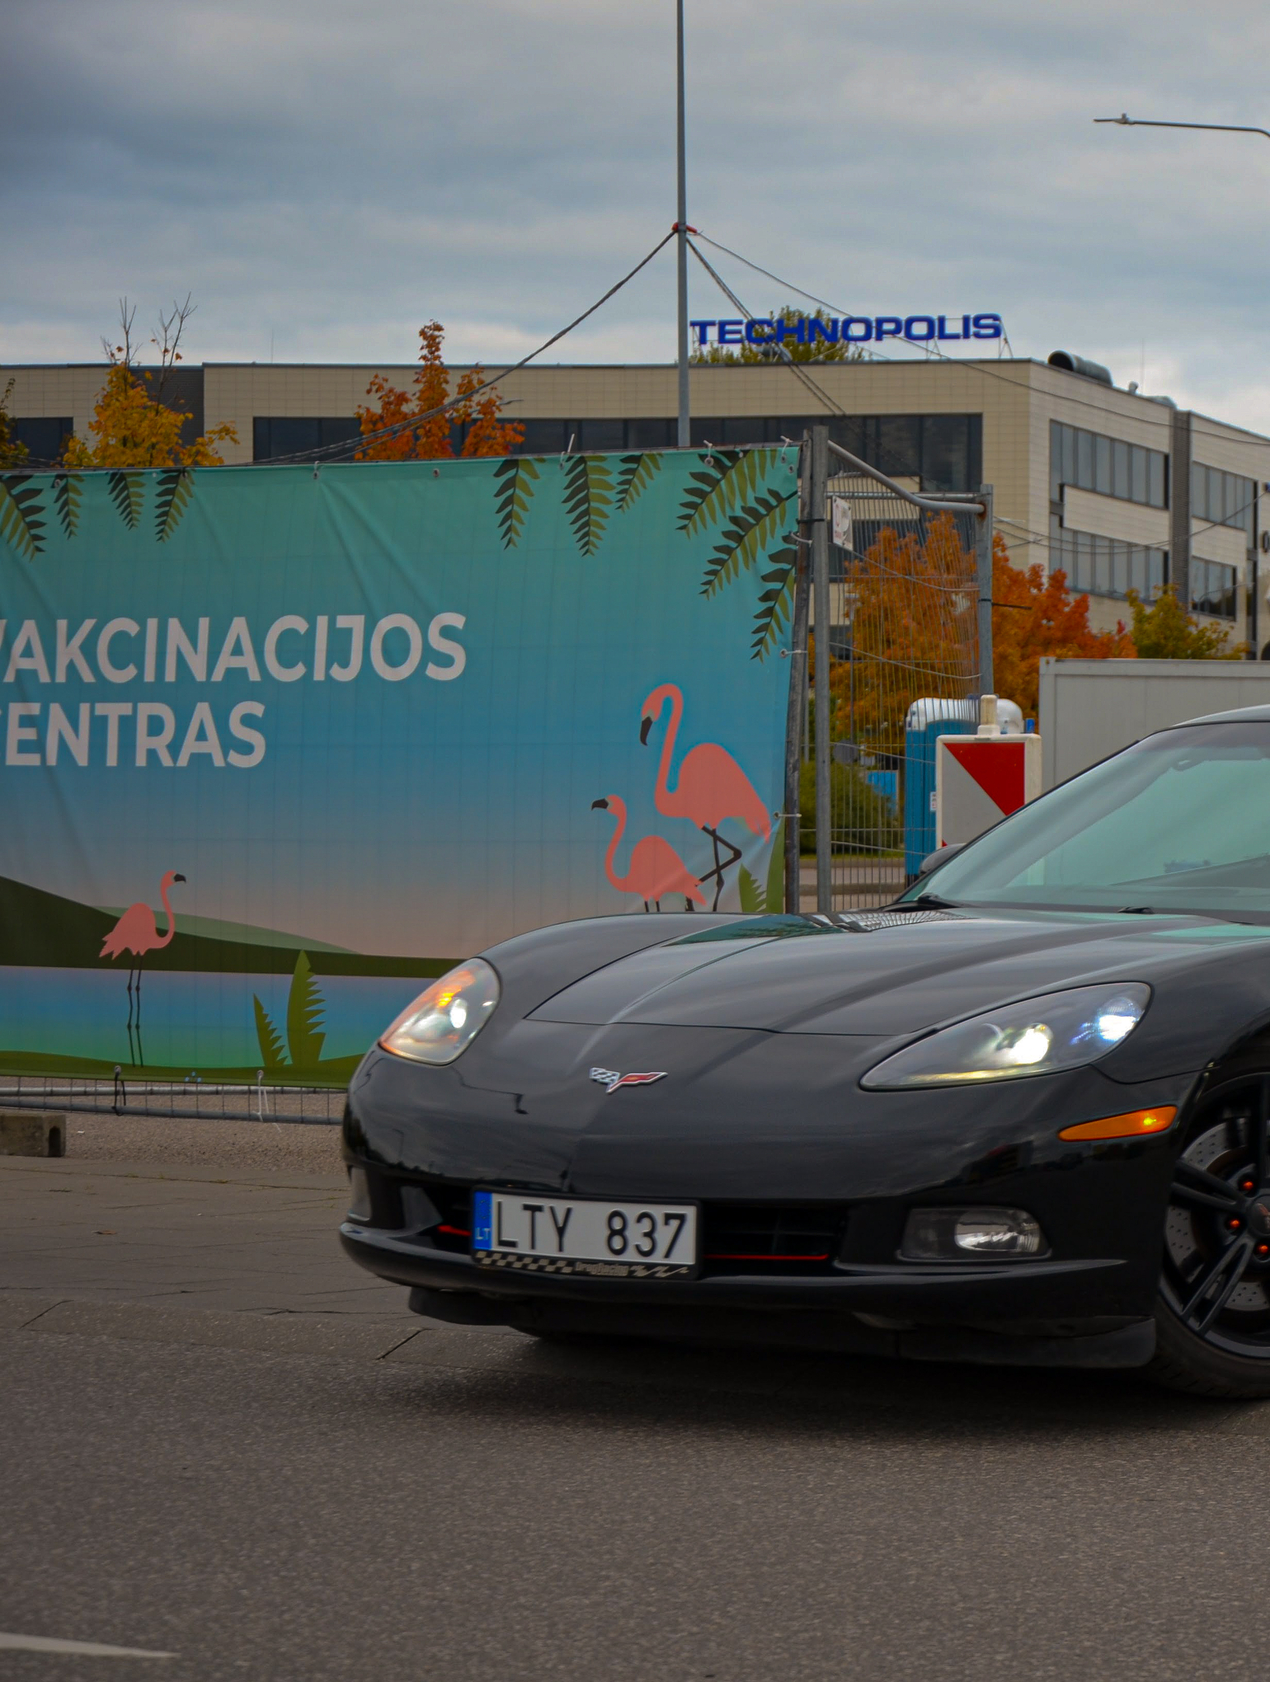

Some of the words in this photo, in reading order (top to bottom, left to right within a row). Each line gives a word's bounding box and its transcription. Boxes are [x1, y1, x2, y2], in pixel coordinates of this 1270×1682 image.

[690, 312, 1002, 345] TECHNOPOLIS
[0, 612, 467, 684] AKCINACIJOS
[0, 701, 267, 769] ENTRAS
[475, 1227, 491, 1240] LT
[497, 1201, 573, 1252] LTY
[607, 1210, 687, 1258] 837
